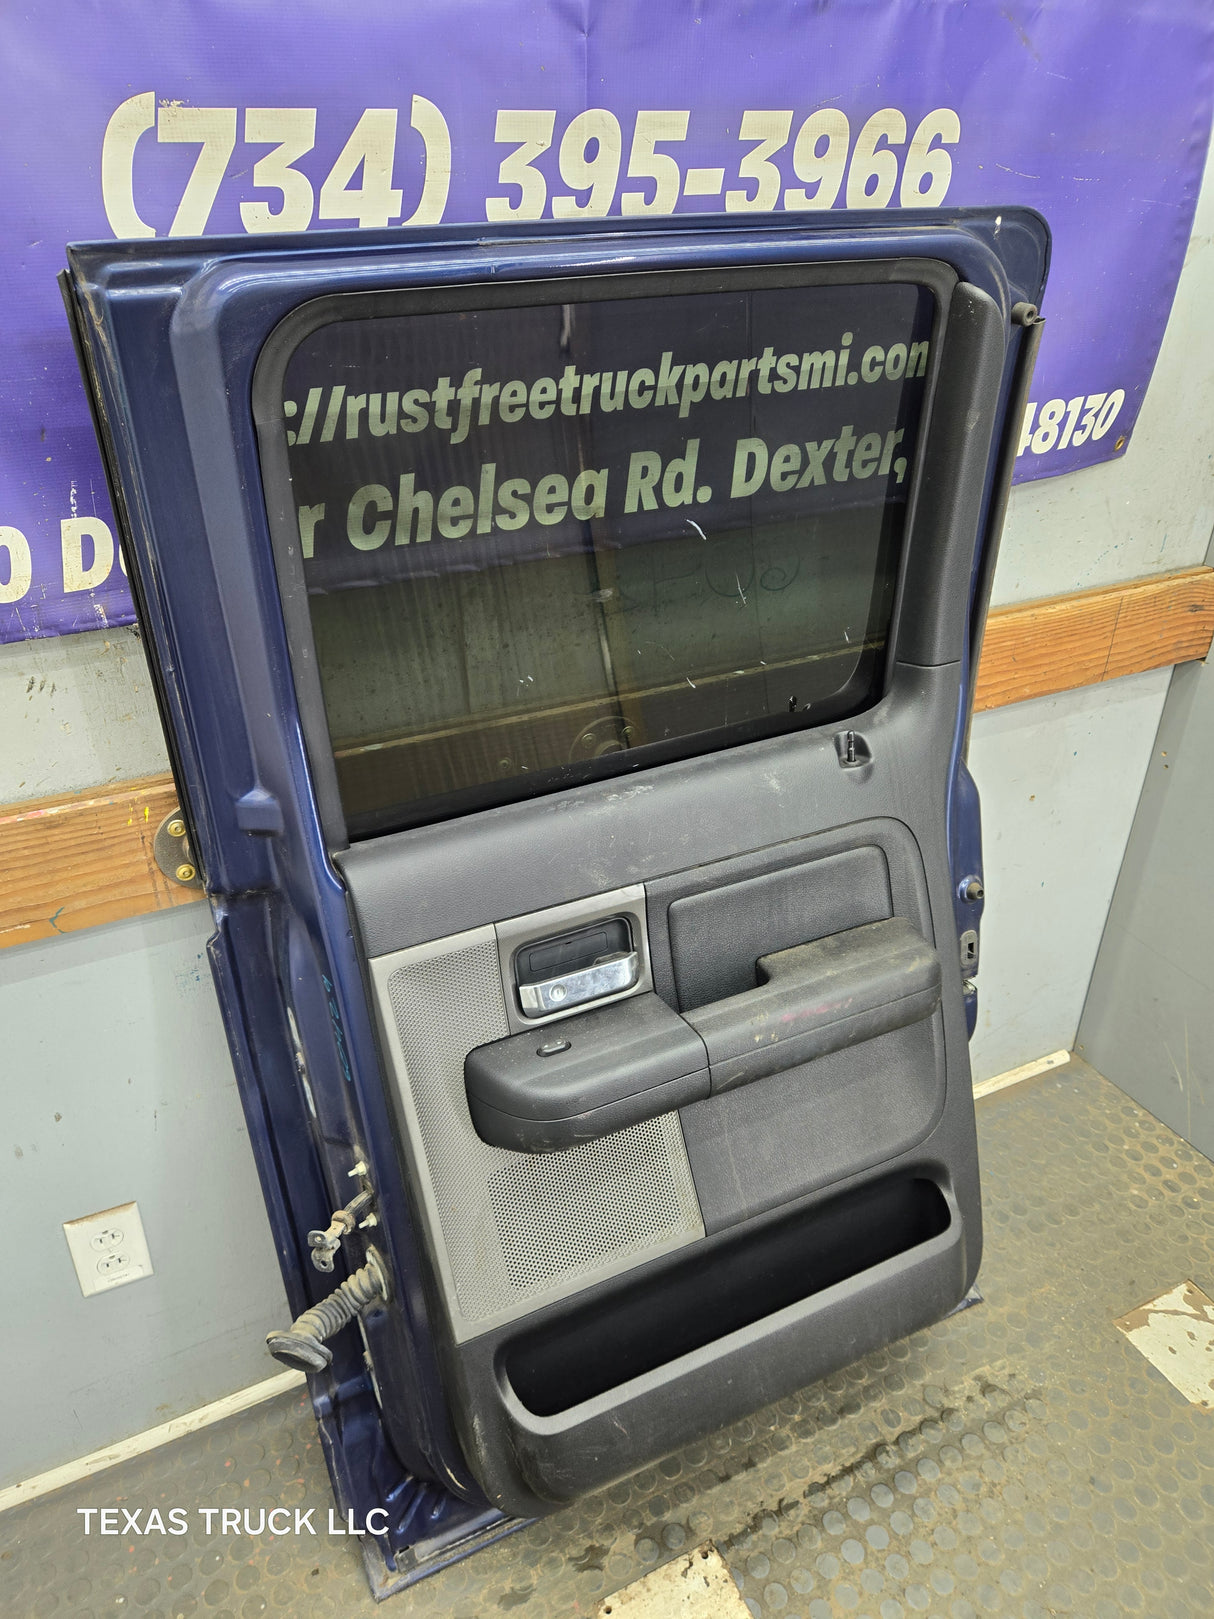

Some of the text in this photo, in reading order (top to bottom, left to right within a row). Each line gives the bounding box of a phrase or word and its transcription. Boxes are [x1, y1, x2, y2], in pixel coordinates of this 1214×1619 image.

[102, 91, 961, 239] (734) 395-3966
[347, 458, 608, 553] Chelsea
[624, 445, 712, 514] Rd.
[730, 425, 907, 500] Dexter,
